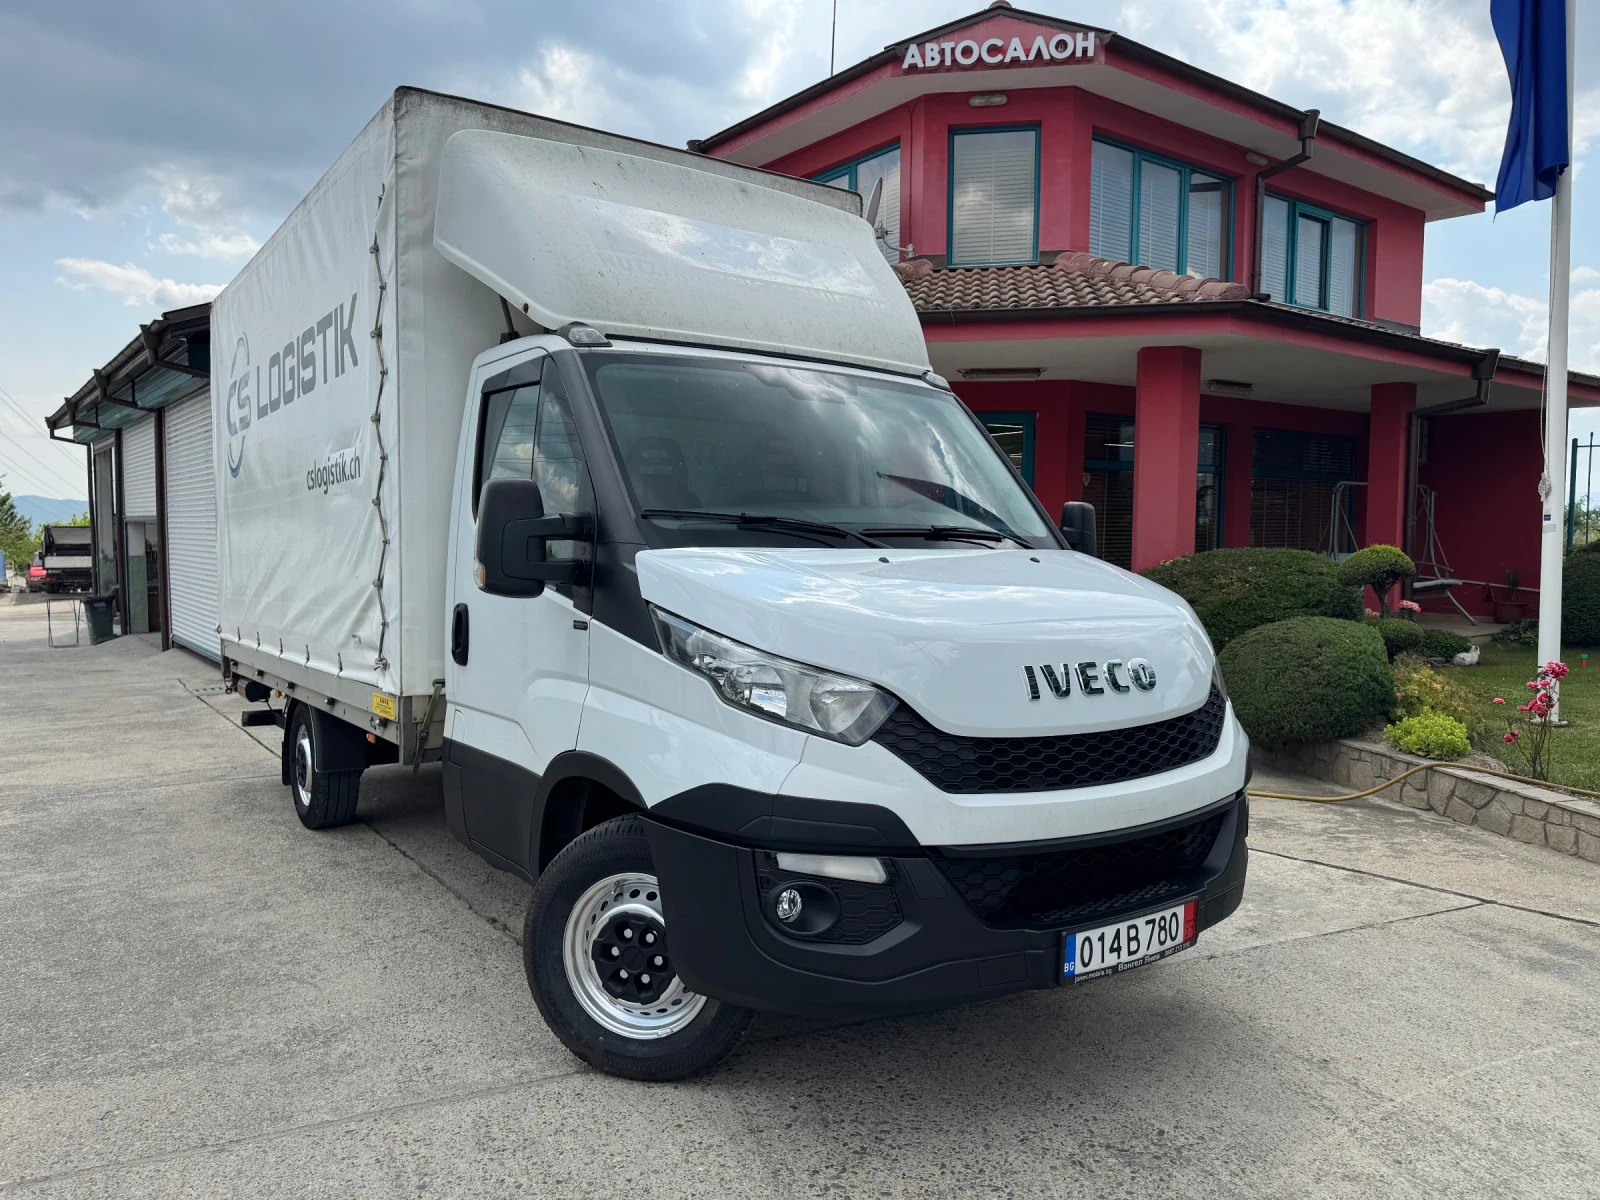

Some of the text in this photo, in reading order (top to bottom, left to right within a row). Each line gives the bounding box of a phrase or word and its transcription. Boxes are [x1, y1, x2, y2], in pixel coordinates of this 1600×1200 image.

[902, 31, 1096, 70] АВТОСАЛОН
[256, 291, 359, 420] LOGISTIK
[306, 447, 361, 495] cslogistik.ch
[1020, 657, 1157, 700] IVECO
[1080, 911, 1180, 968] 014B780
[1064, 961, 1075, 973] BG
